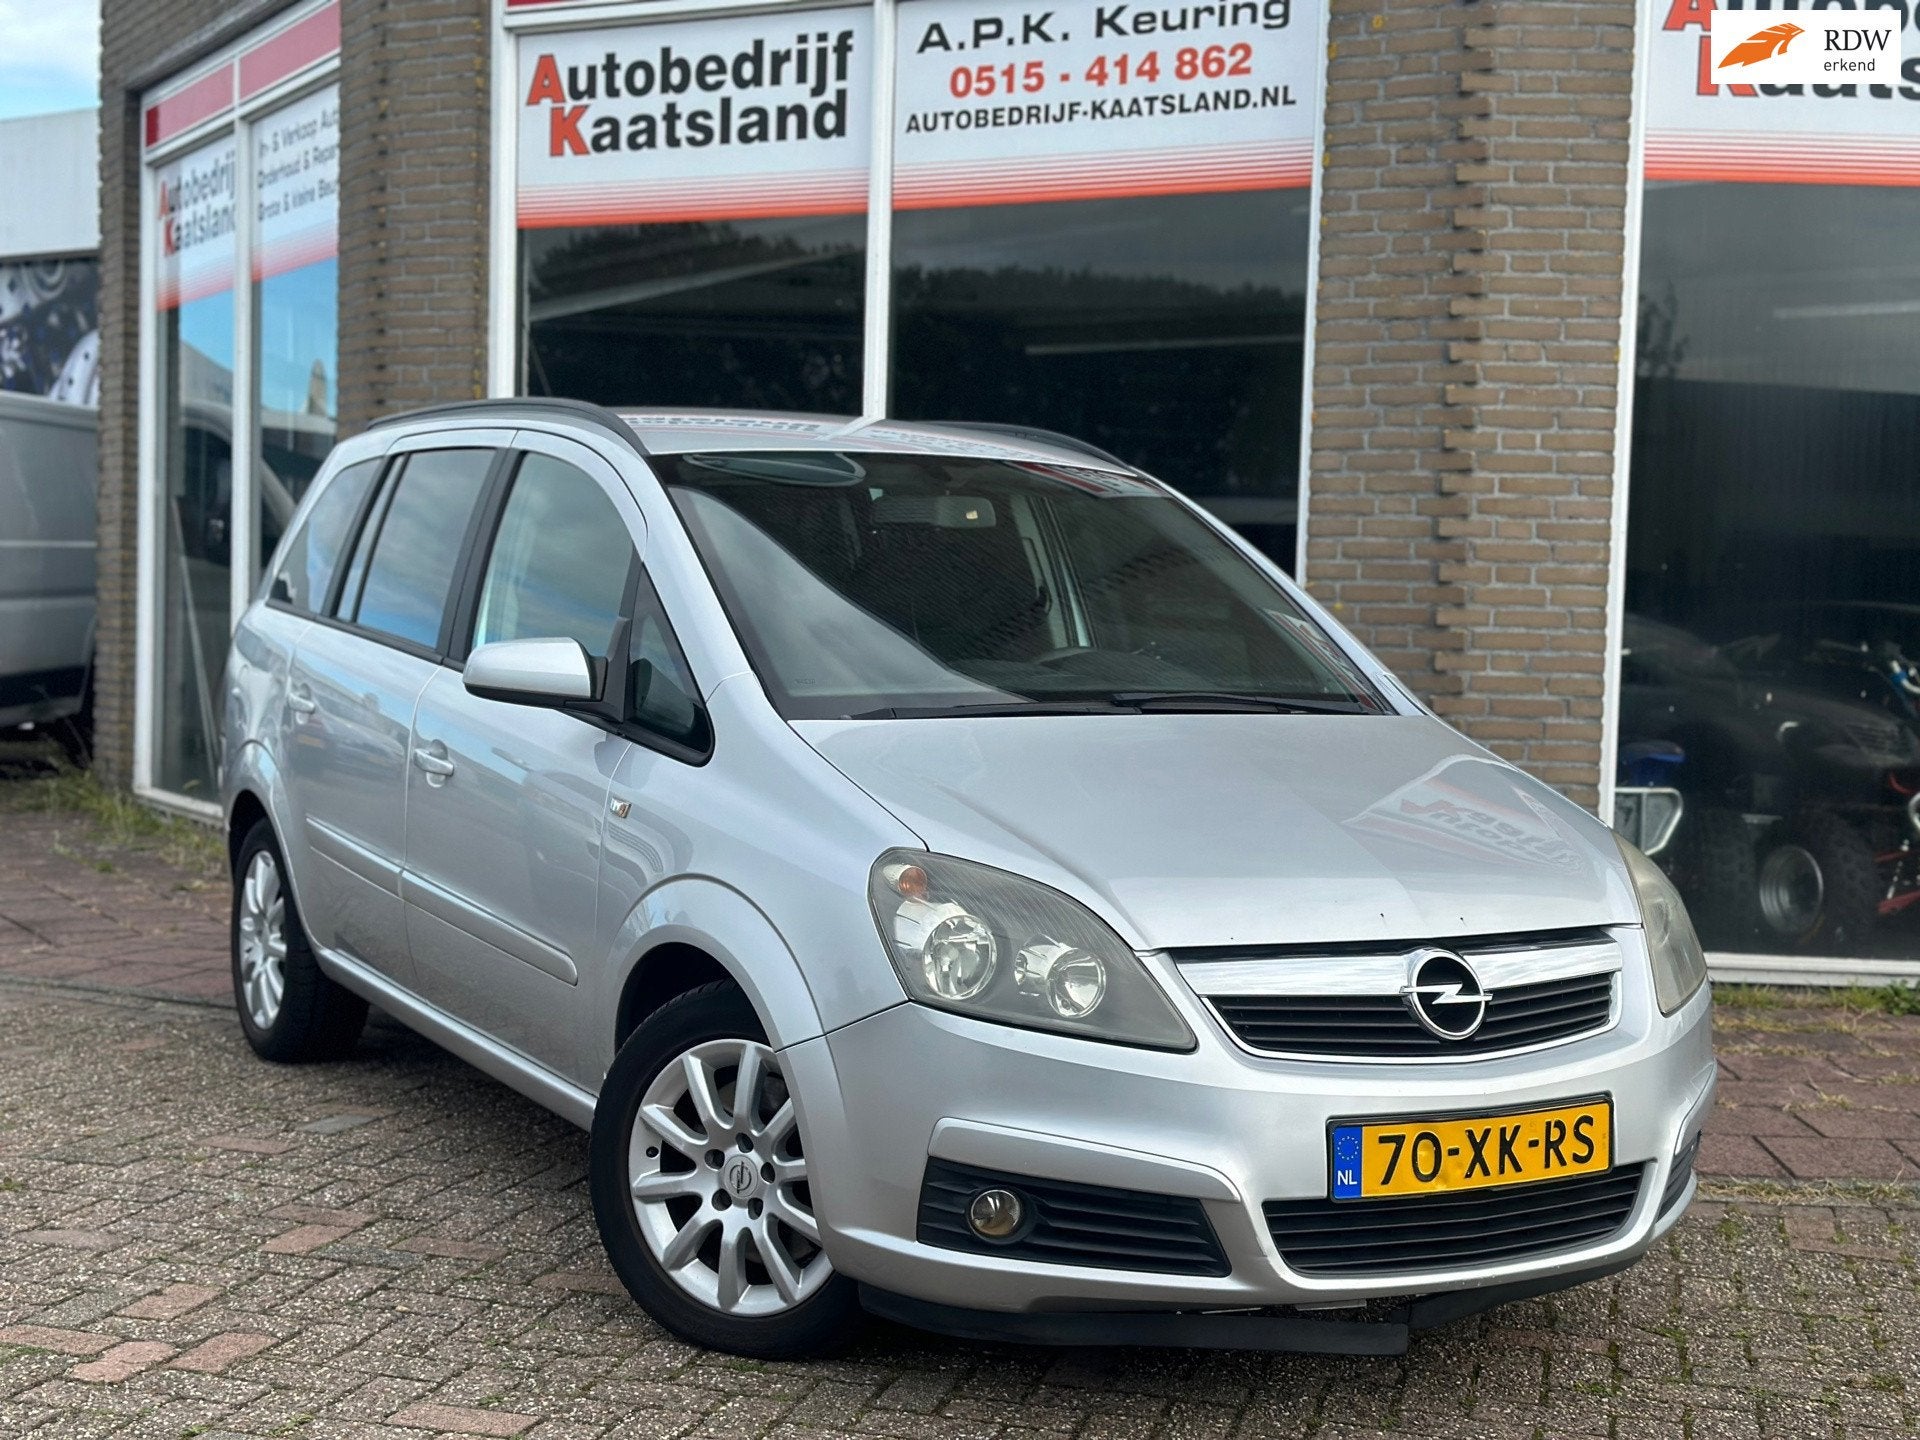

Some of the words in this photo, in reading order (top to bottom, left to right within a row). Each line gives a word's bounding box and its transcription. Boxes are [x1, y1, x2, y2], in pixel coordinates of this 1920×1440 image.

[917, 12, 1069, 54] A.P.K.
[1095, 0, 1292, 38] Keuring
[525, 29, 853, 106] Autobedrijf
[949, 56, 1045, 98] 0515
[1085, 51, 1158, 86] 414
[1175, 42, 1253, 80] 862
[549, 88, 847, 157] Kaatsland
[905, 86, 1296, 134] AUTOBEDRIJF-KAATSLAND.NL
[1337, 1169, 1357, 1186] NL
[1377, 1114, 1594, 1186] 70-XK-RS
